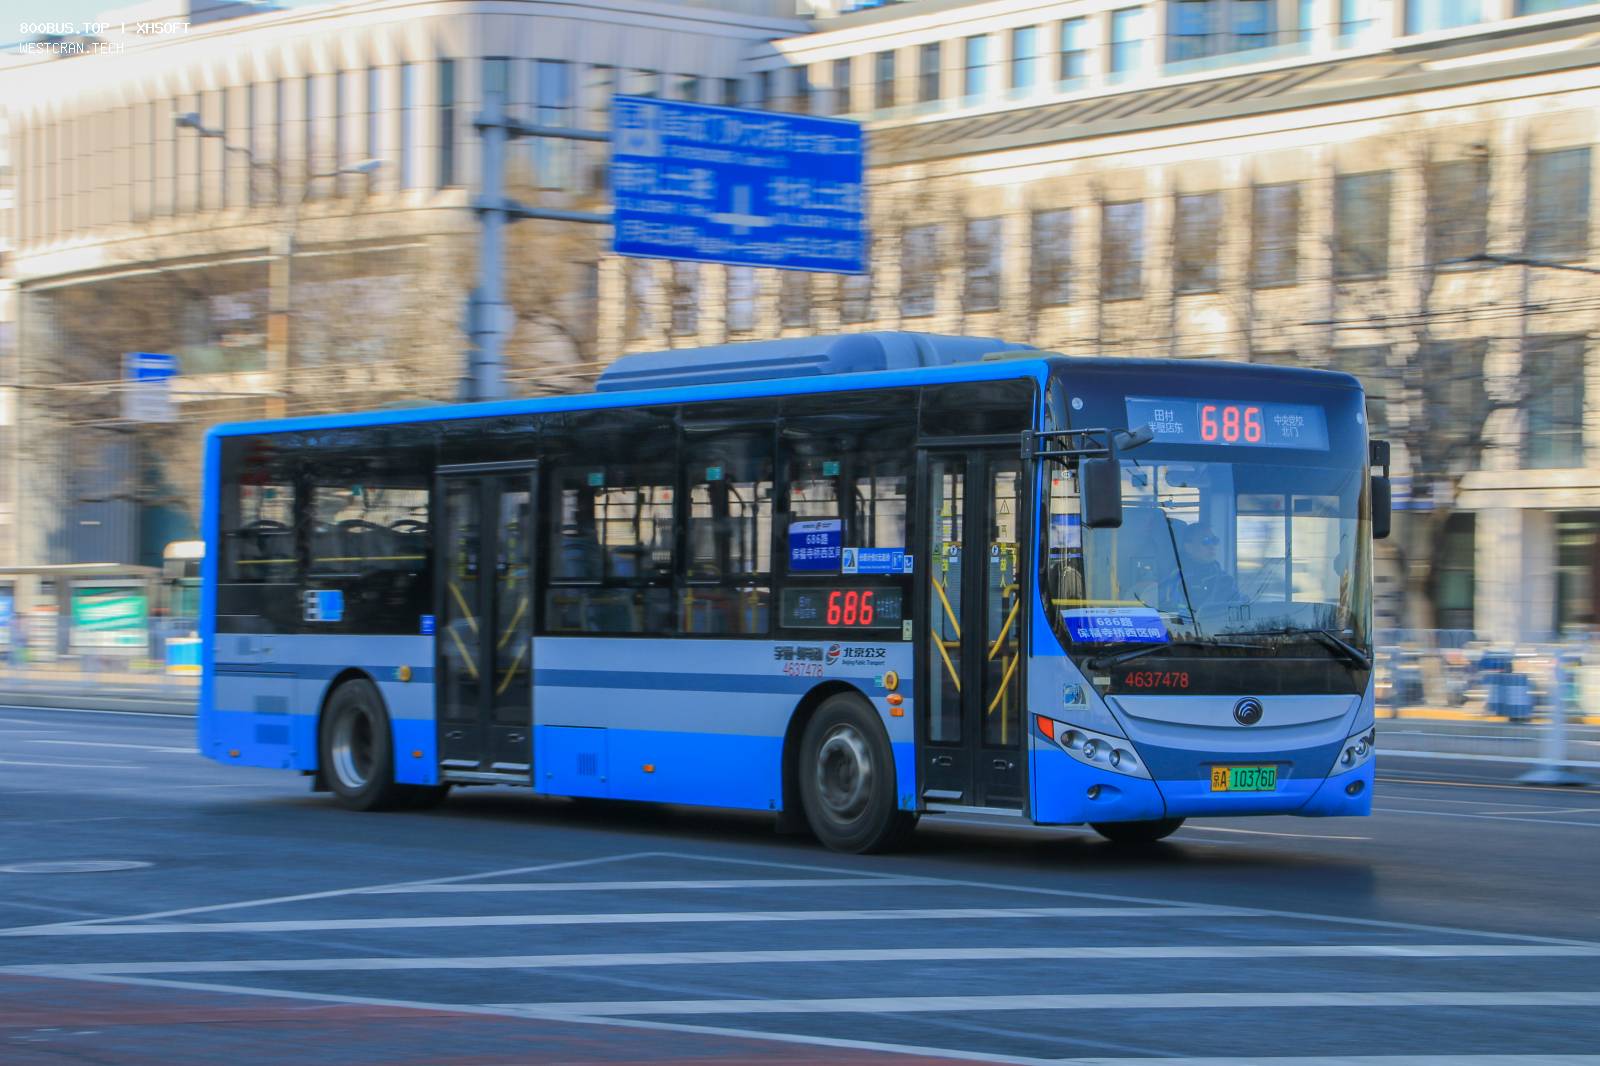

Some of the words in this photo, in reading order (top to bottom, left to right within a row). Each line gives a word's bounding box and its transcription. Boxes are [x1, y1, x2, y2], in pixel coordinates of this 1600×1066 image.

[1201, 405, 1262, 443] 686
[827, 590, 874, 625] 686
[1096, 617, 1133, 627] 686路
[843, 647, 887, 658] 北京公交
[783, 662, 824, 678] 4637478
[1125, 671, 1189, 688] 4637478
